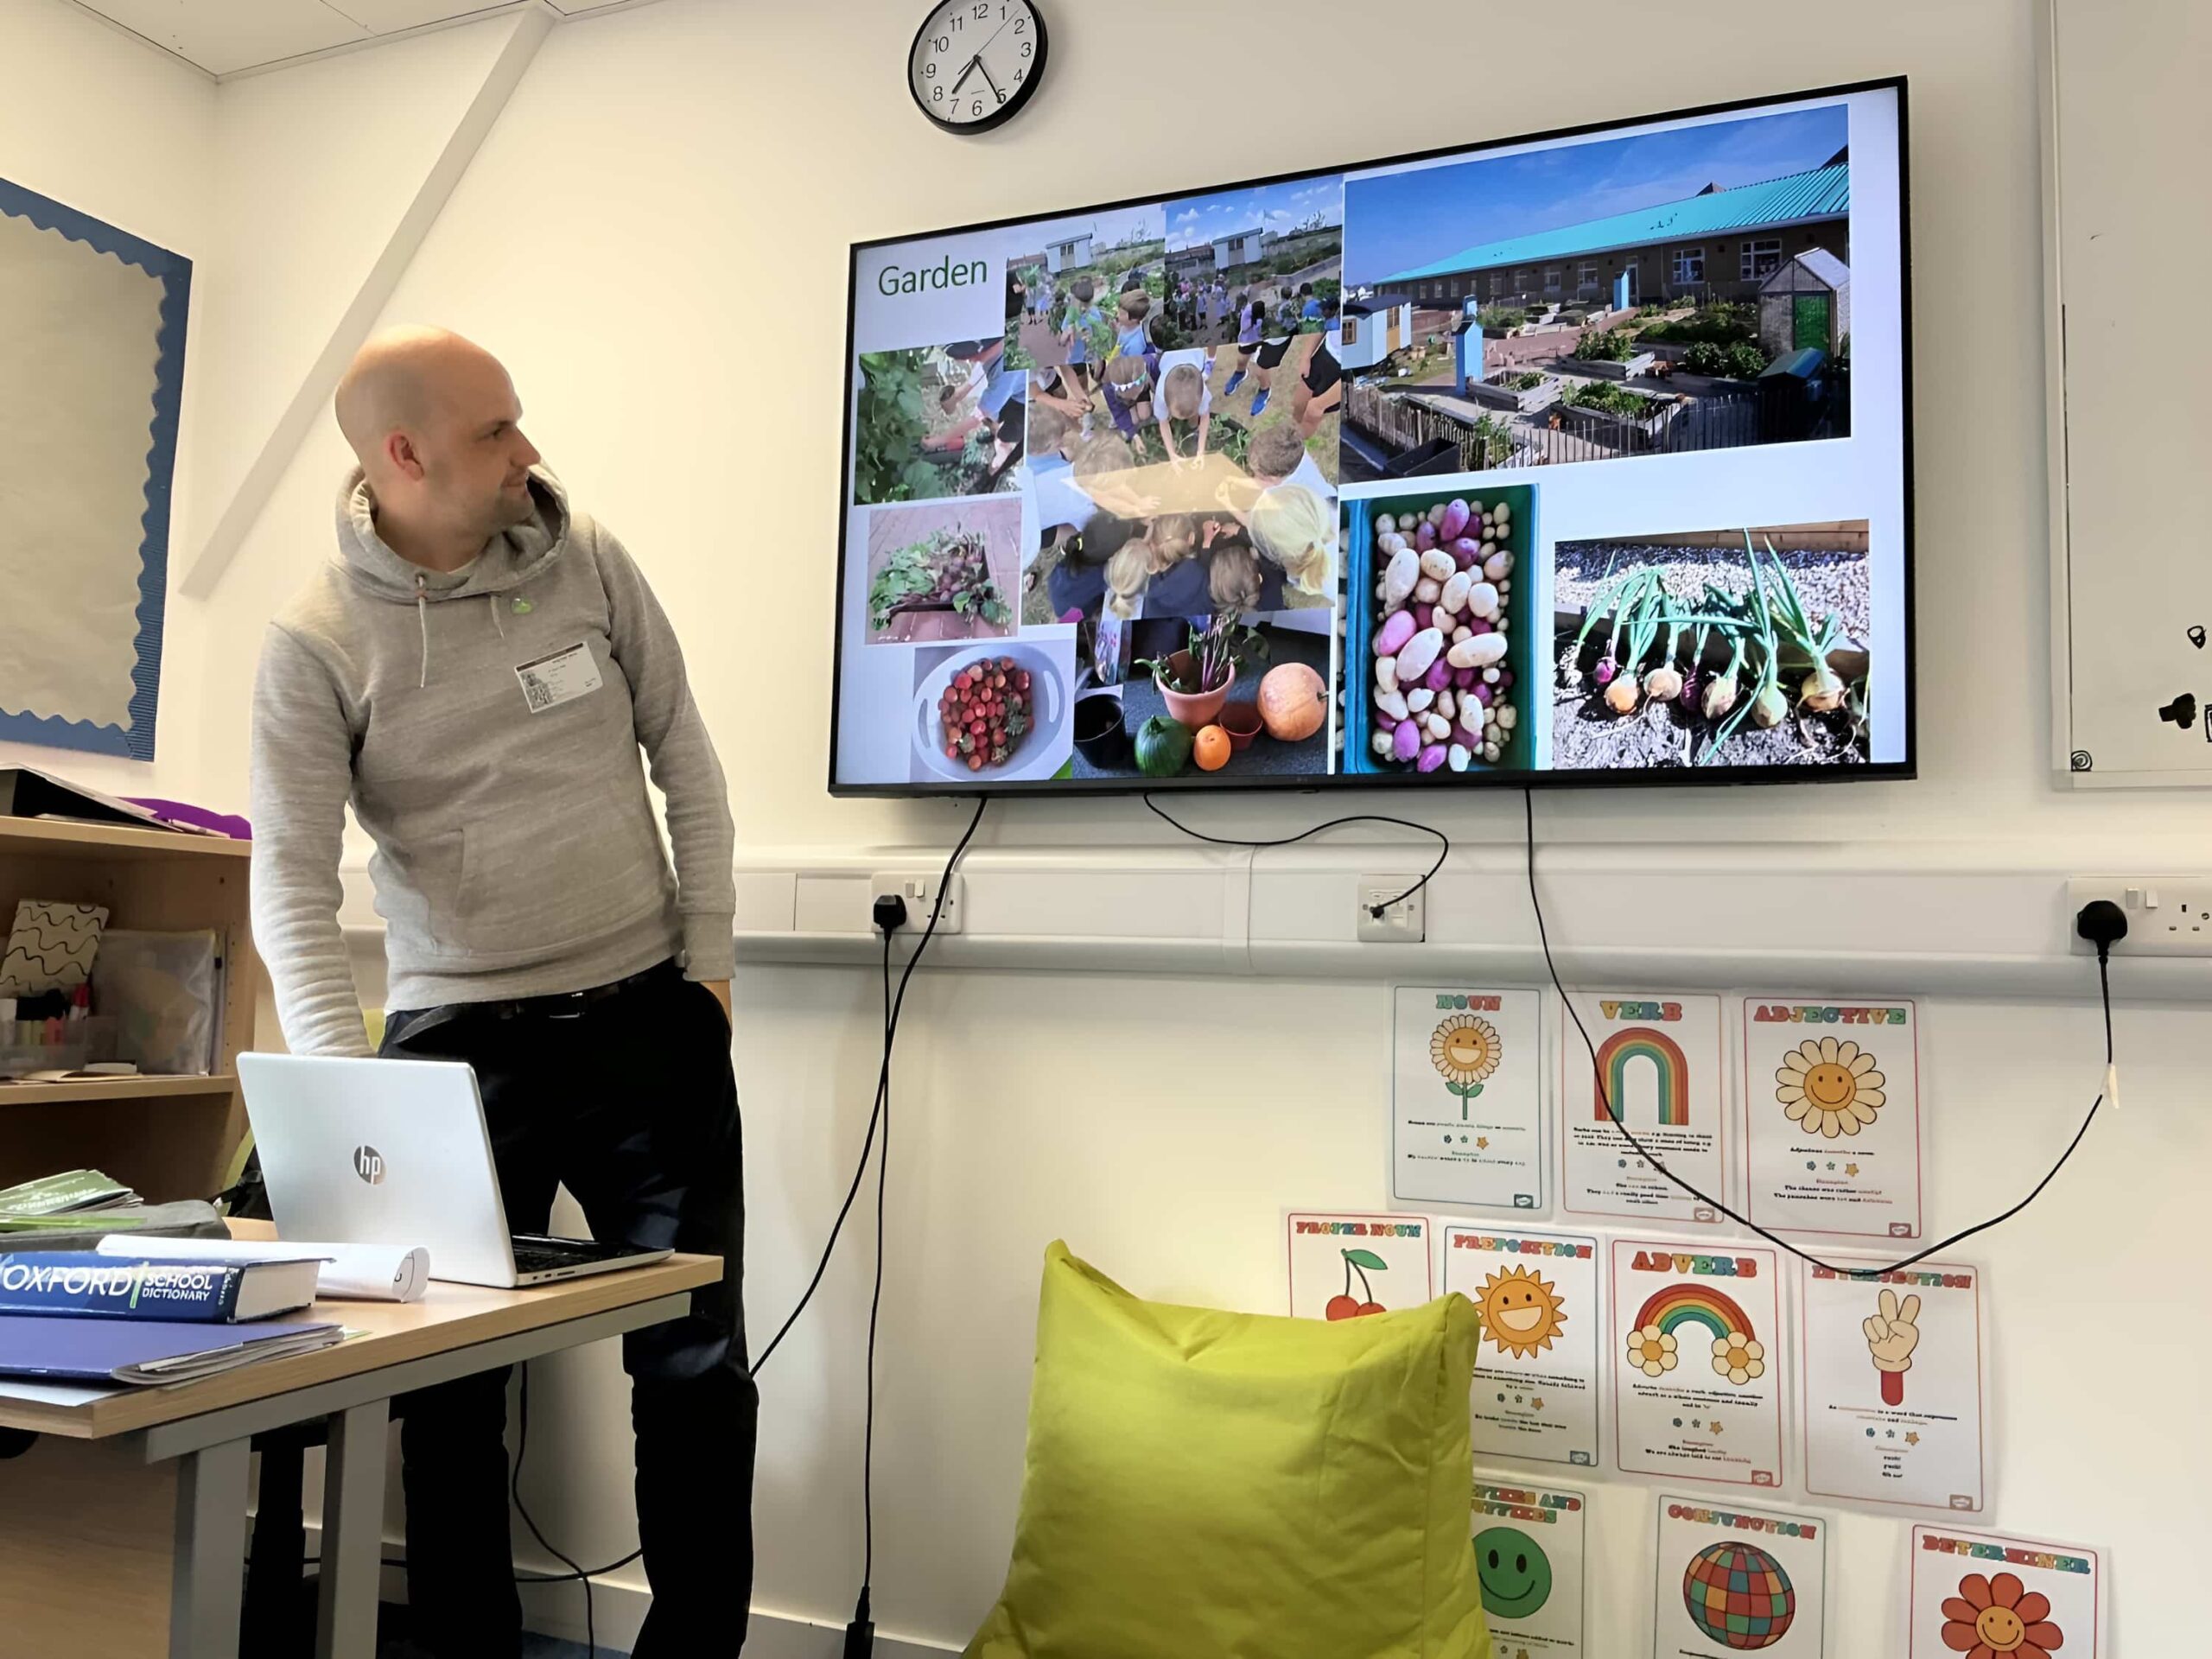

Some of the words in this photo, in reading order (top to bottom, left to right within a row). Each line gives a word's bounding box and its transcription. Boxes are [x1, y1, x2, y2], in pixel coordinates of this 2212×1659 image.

[971, 3, 988, 20] 12
[1000, 5, 1006, 20] 1
[950, 16, 963, 32] 11
[1014, 18, 1026, 35] 2
[934, 36, 950, 53] 10
[1020, 41, 1032, 58] 3
[925, 63, 937, 79] 9
[1014, 68, 1023, 83] 4
[933, 86, 943, 101] 8
[997, 88, 1007, 104] 5
[950, 99, 959, 114] 7
[971, 100, 982, 117] 6
[878, 255, 987, 296] Garden
[1436, 995, 1501, 1011] NOUN
[1599, 1001, 1682, 1021] VERB
[1753, 1005, 1906, 1025] ADJECTIVE
[359, 1146, 381, 1185] hp
[1296, 1222, 1368, 1236] PROPER
[1370, 1223, 1422, 1237] NOUN
[1453, 1234, 1592, 1259] PREPOSITION
[1631, 1251, 1757, 1278] ADVERB
[3, 1264, 132, 1296] OXFORD
[144, 1273, 213, 1290] SCHOOL
[142, 1287, 210, 1301] DICTIONARY
[1539, 1493, 1581, 1511] AND
[1668, 1503, 1817, 1541] CONJUNCTION
[1923, 1535, 2091, 1575] DETERMINER
